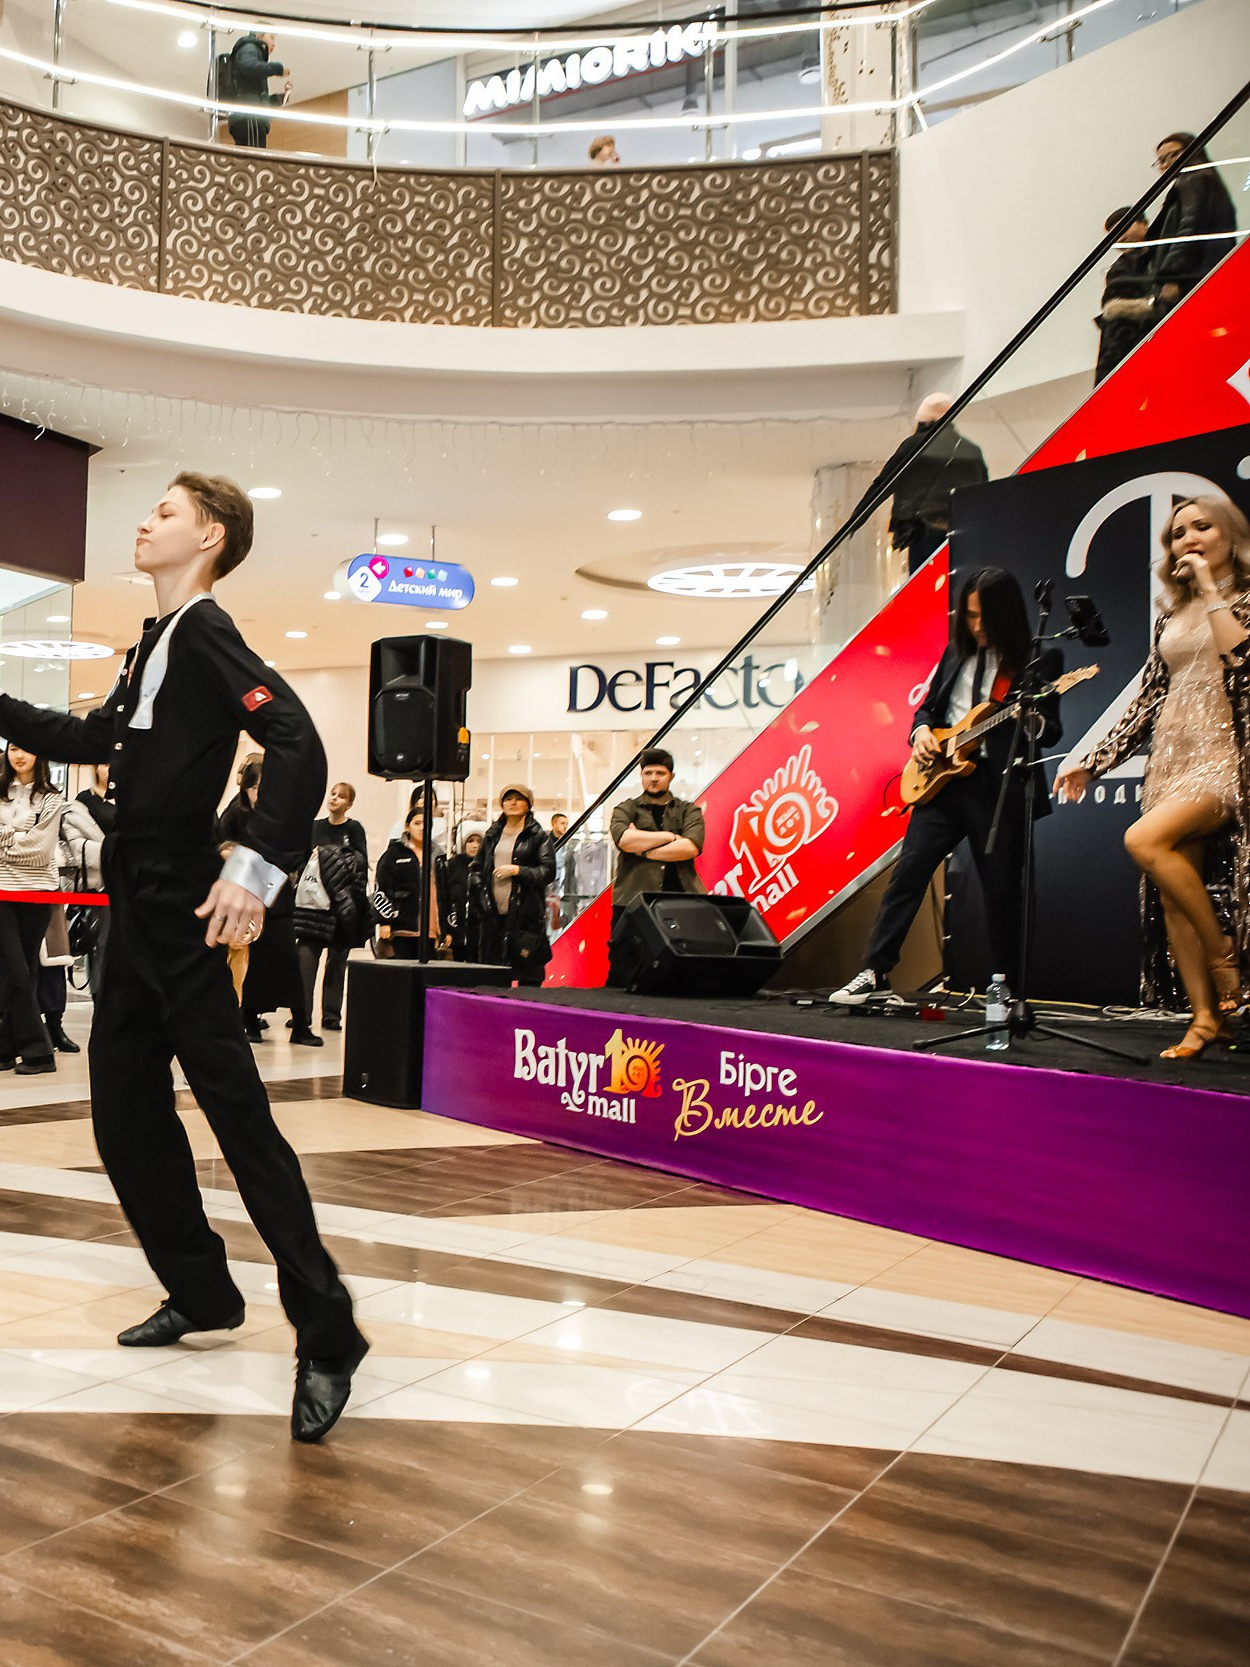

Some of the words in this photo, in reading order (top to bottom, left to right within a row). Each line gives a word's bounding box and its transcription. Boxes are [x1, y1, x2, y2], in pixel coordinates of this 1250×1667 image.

[360, 572, 369, 589] 2
[388, 579, 437, 597] Детский
[438, 587, 463, 600] мир
[566, 655, 805, 713] DeFacto
[514, 1028, 605, 1111] Batyr
[719, 1050, 798, 1097] Бірге
[587, 1094, 637, 1124] mall
[672, 1078, 824, 1142] Вместе
